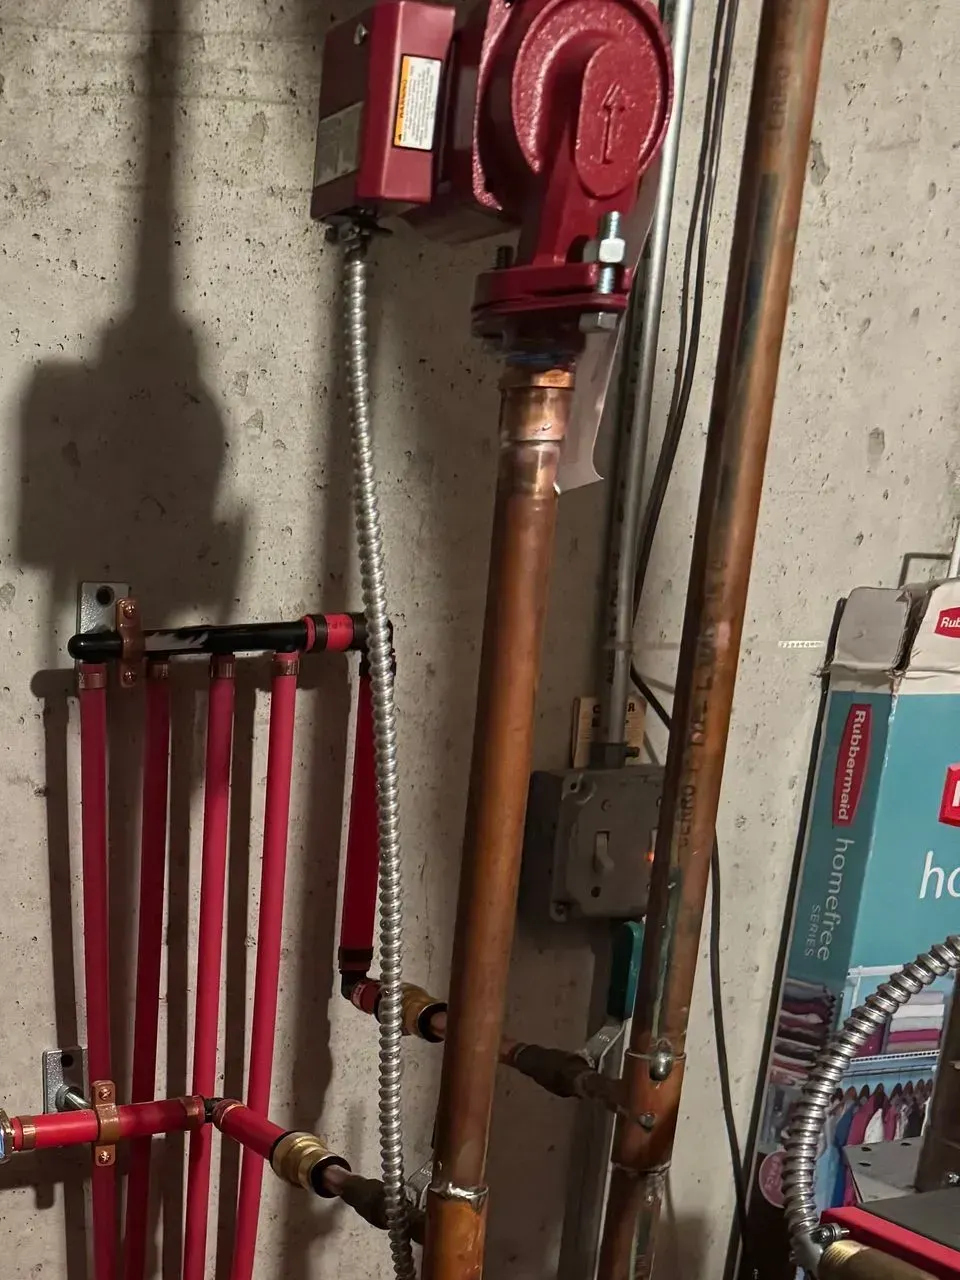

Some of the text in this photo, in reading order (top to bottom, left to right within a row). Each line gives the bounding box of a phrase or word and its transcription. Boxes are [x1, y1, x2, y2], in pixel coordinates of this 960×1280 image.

[837, 709, 867, 820] Rubbermaid
[804, 904, 821, 957] SERIES
[817, 837, 855, 961] homefree
